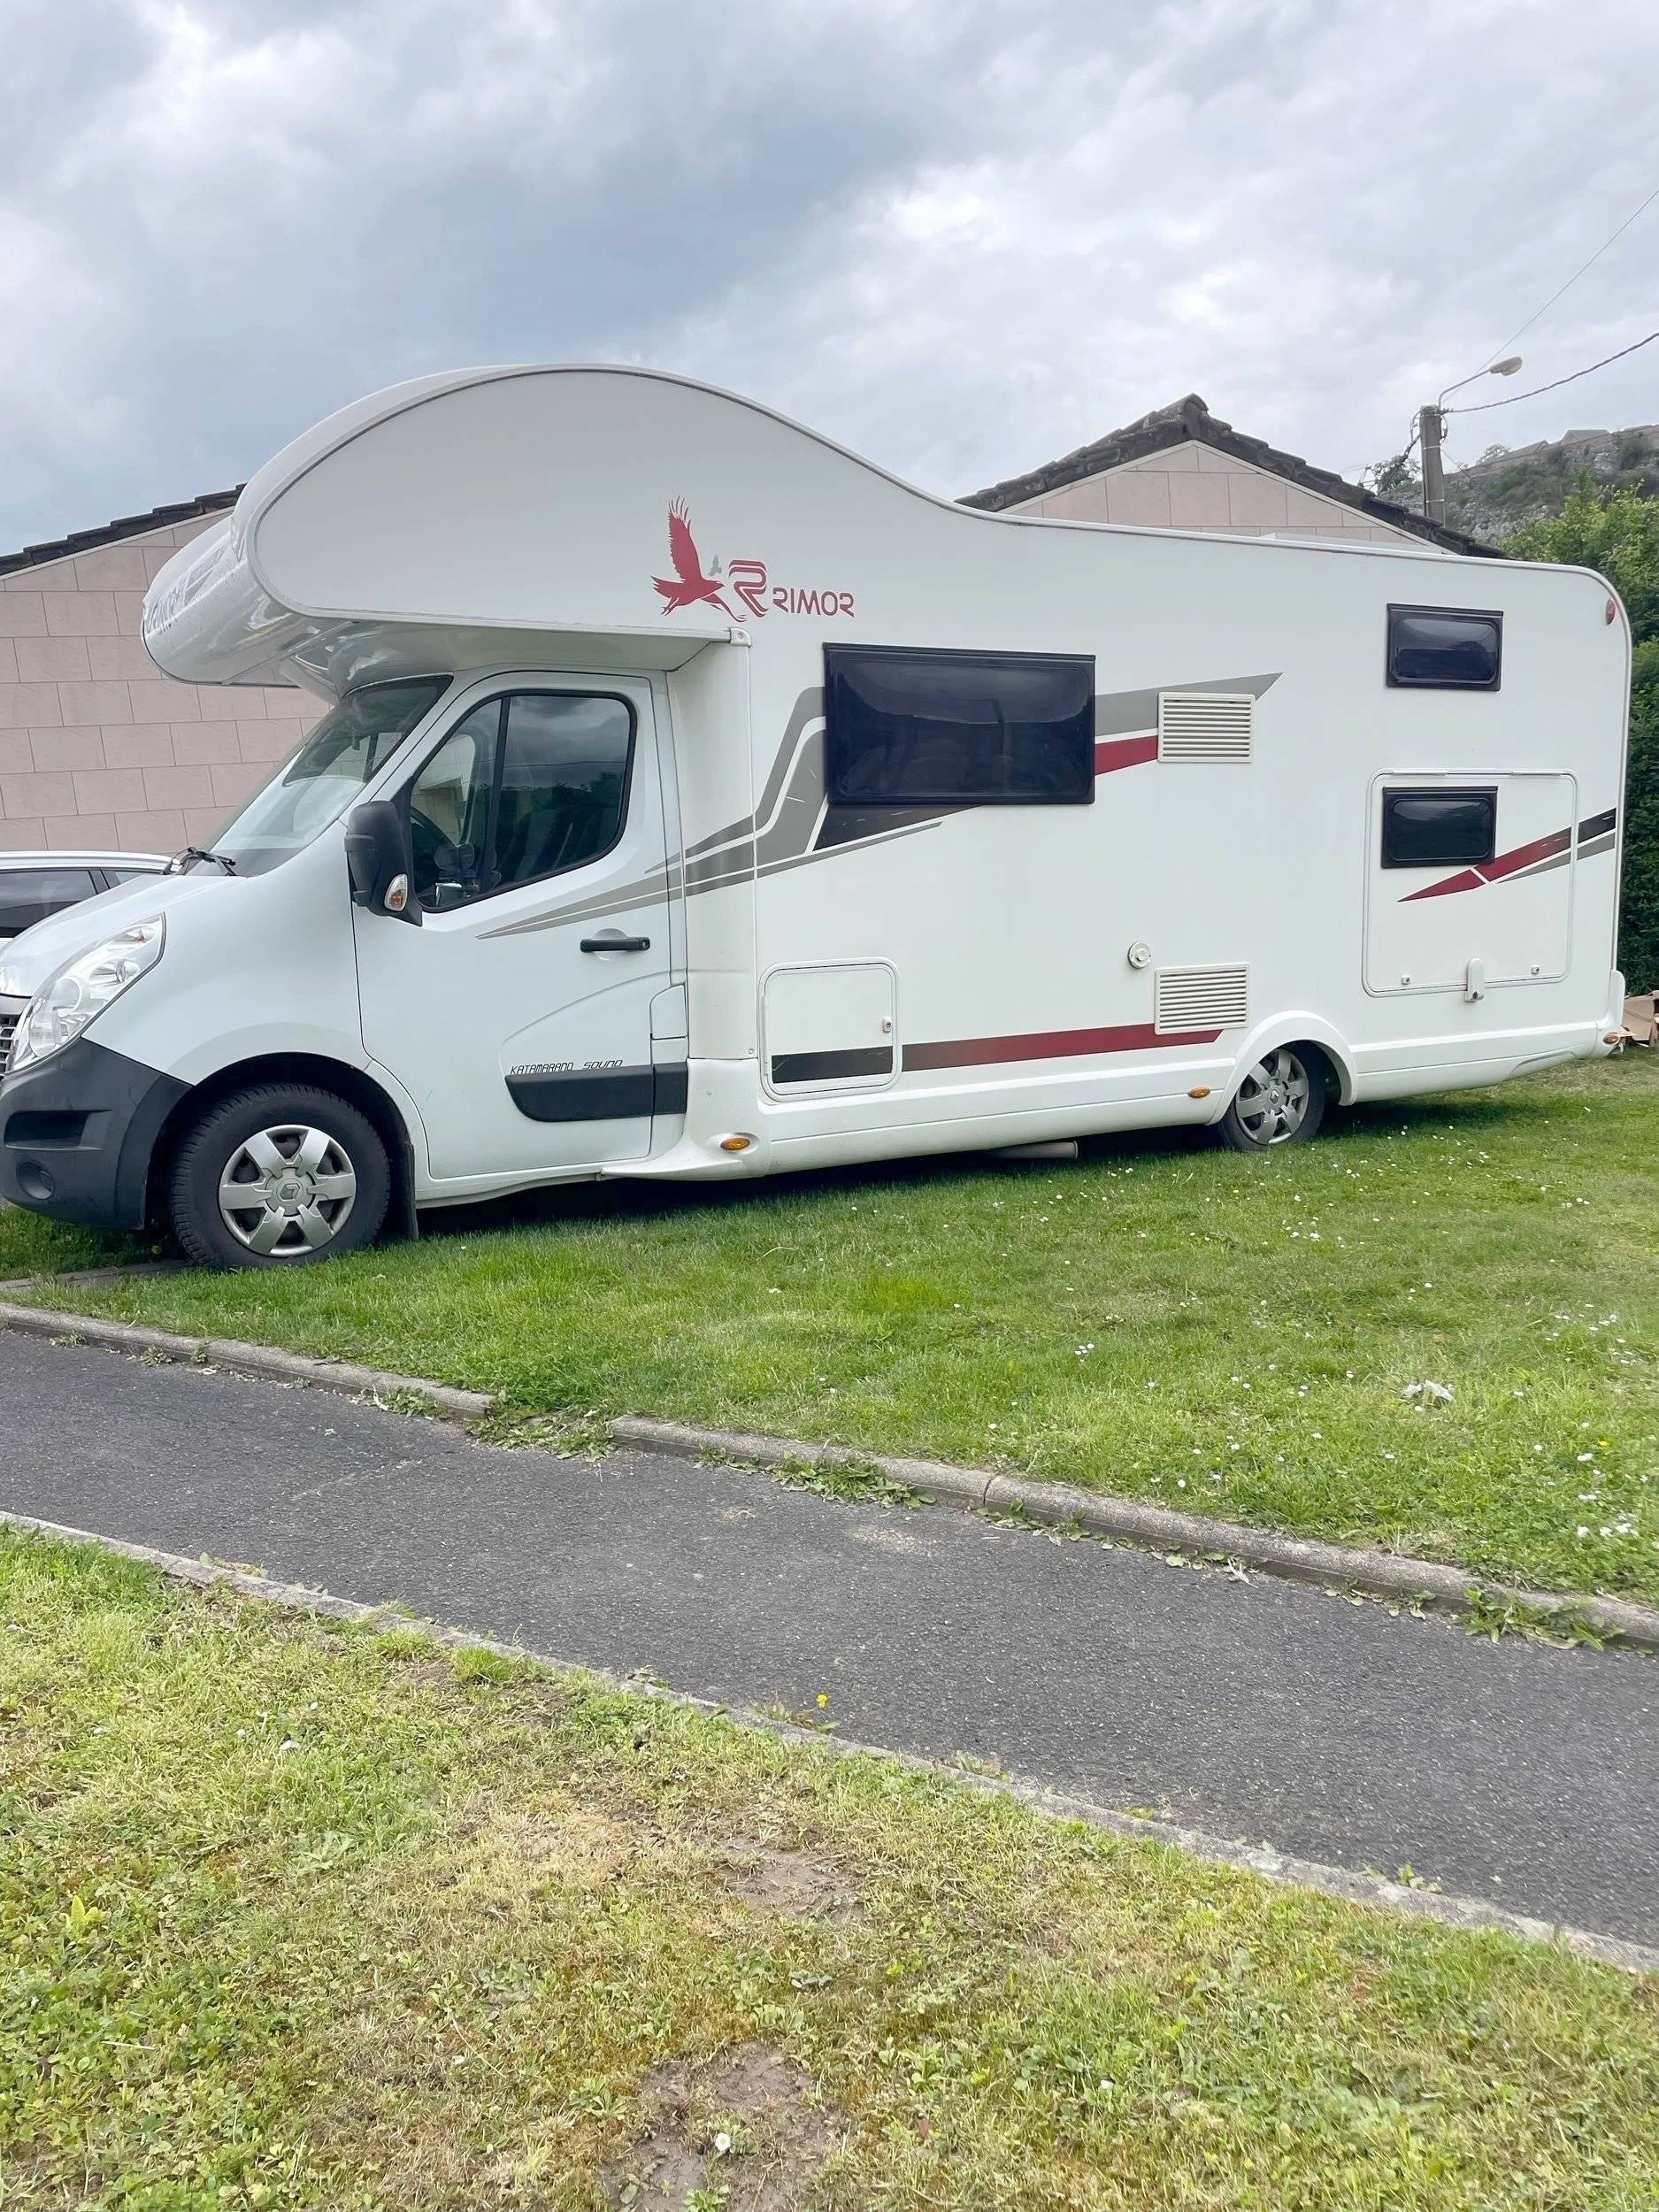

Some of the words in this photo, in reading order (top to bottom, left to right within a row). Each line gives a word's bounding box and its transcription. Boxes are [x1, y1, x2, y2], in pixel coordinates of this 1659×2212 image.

[772, 587, 855, 618] RIMOR
[510, 1062, 574, 1075] KATAMARANO
[583, 1059, 624, 1070] SOUND
